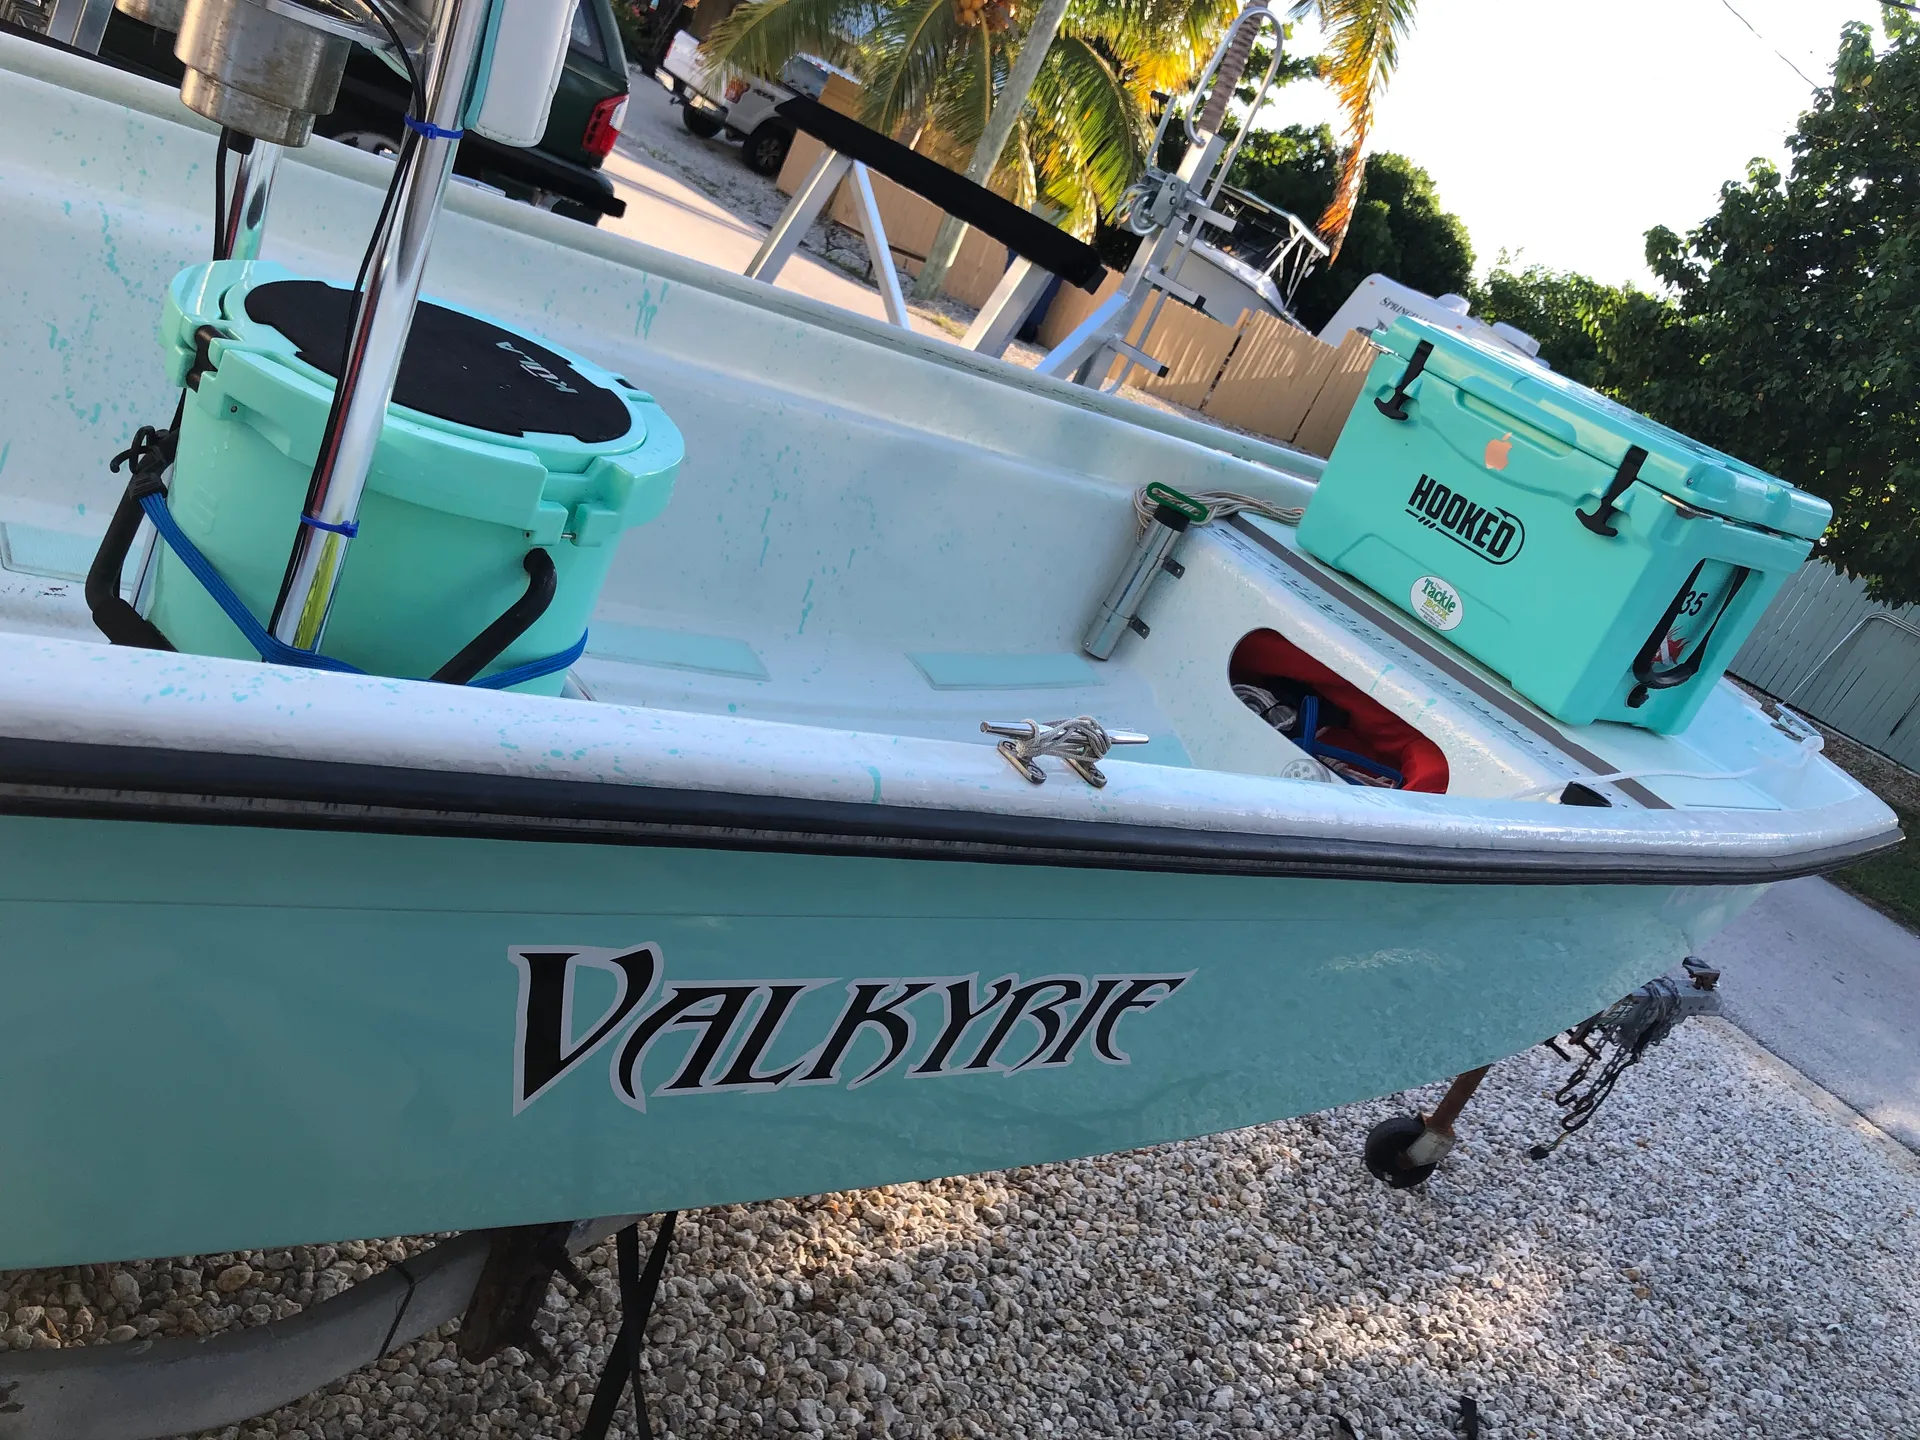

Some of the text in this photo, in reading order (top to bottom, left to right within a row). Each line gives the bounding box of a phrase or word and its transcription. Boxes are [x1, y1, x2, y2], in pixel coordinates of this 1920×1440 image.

[1407, 473, 1516, 558] HOOKED
[1421, 578, 1456, 613] Tackle
[1679, 591, 1708, 616] 35
[509, 942, 1198, 1115] VALKYRIE
